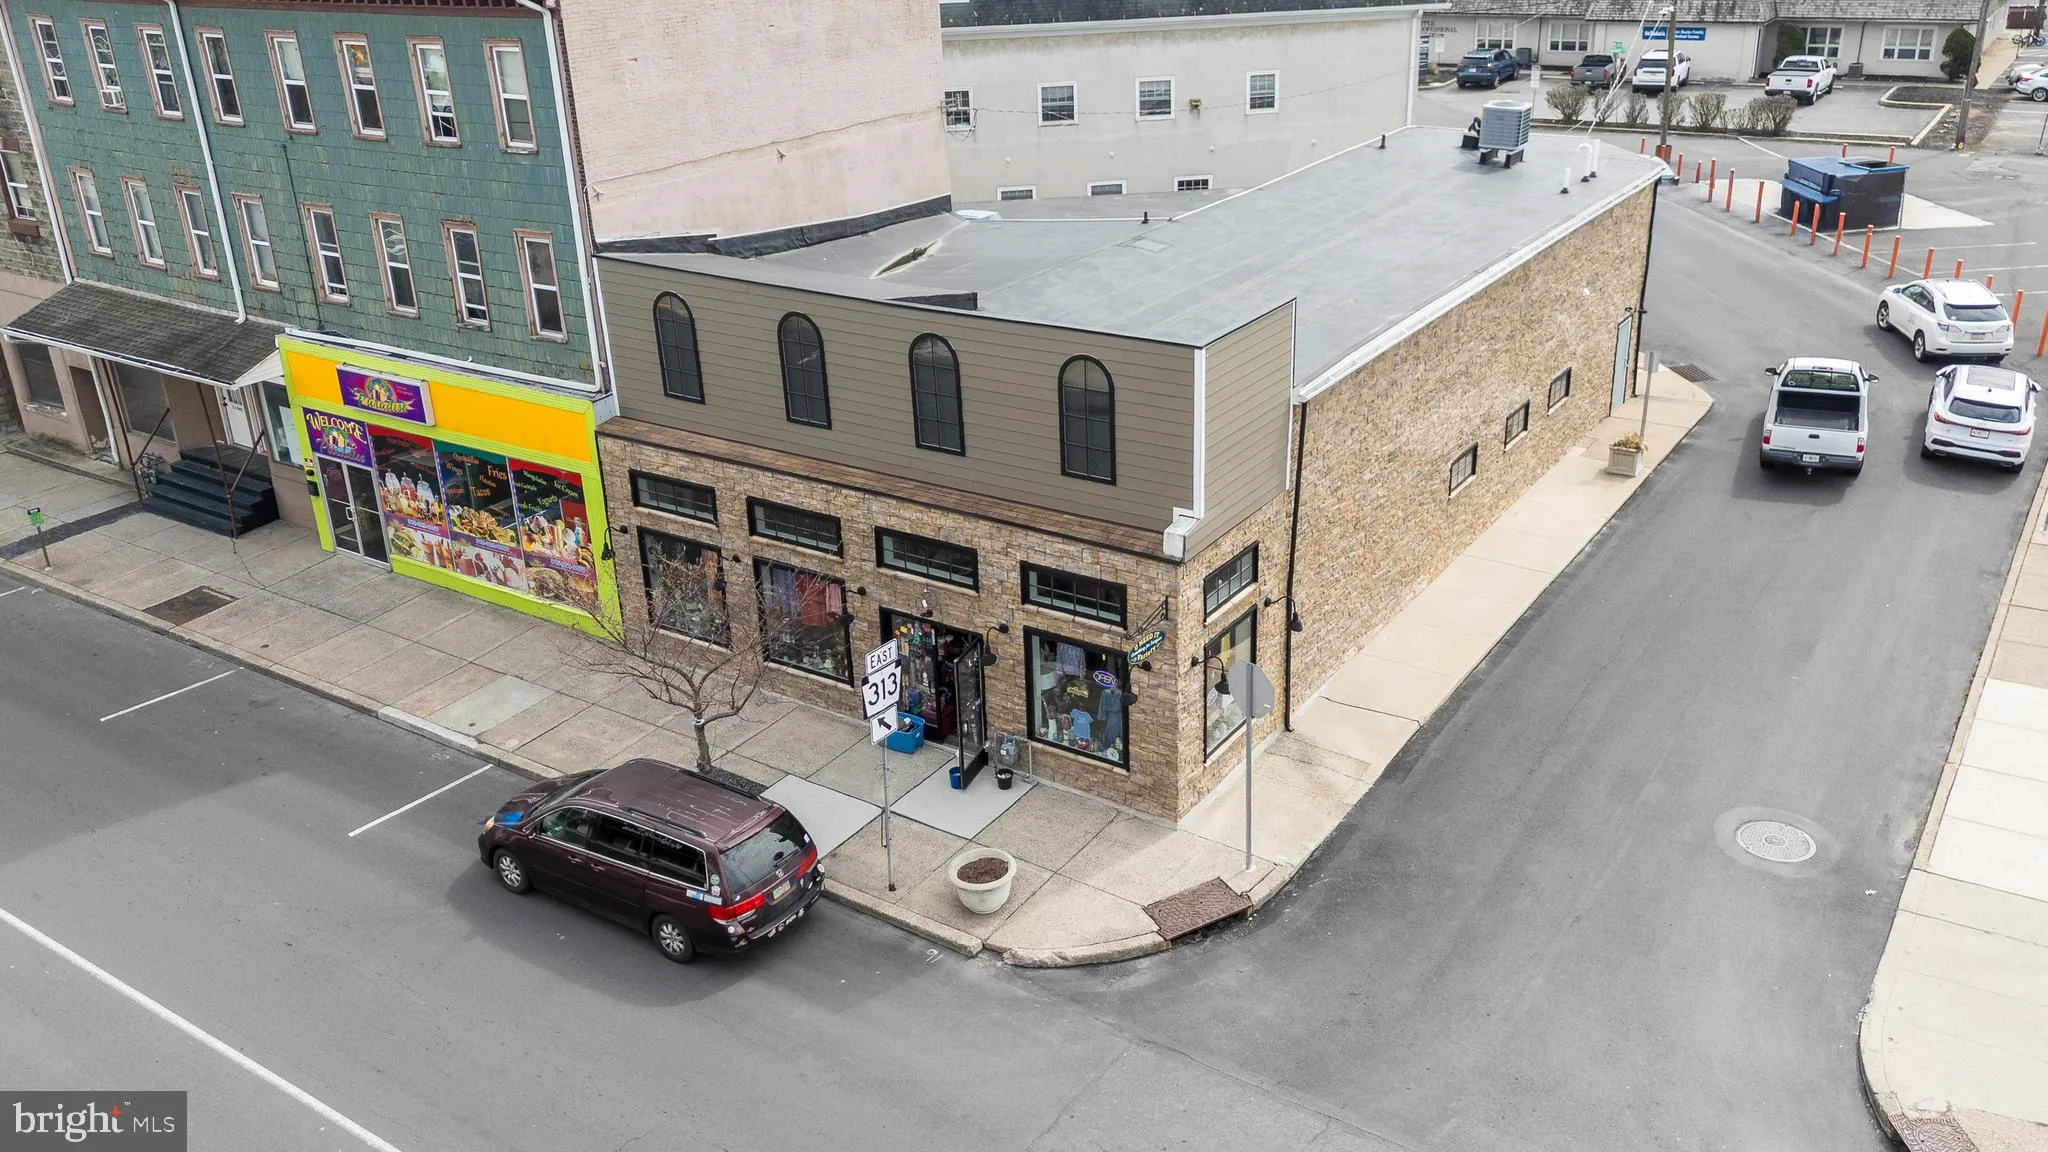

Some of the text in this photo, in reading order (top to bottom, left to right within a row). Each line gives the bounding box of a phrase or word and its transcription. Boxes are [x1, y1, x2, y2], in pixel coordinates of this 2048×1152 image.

[306, 411, 368, 445] WELCOME
[487, 464, 508, 481] Fries
[470, 486, 491, 497] Tacos
[870, 646, 893, 669] EAST
[868, 672, 898, 706] 313
[1094, 671, 1117, 687] OPEN
